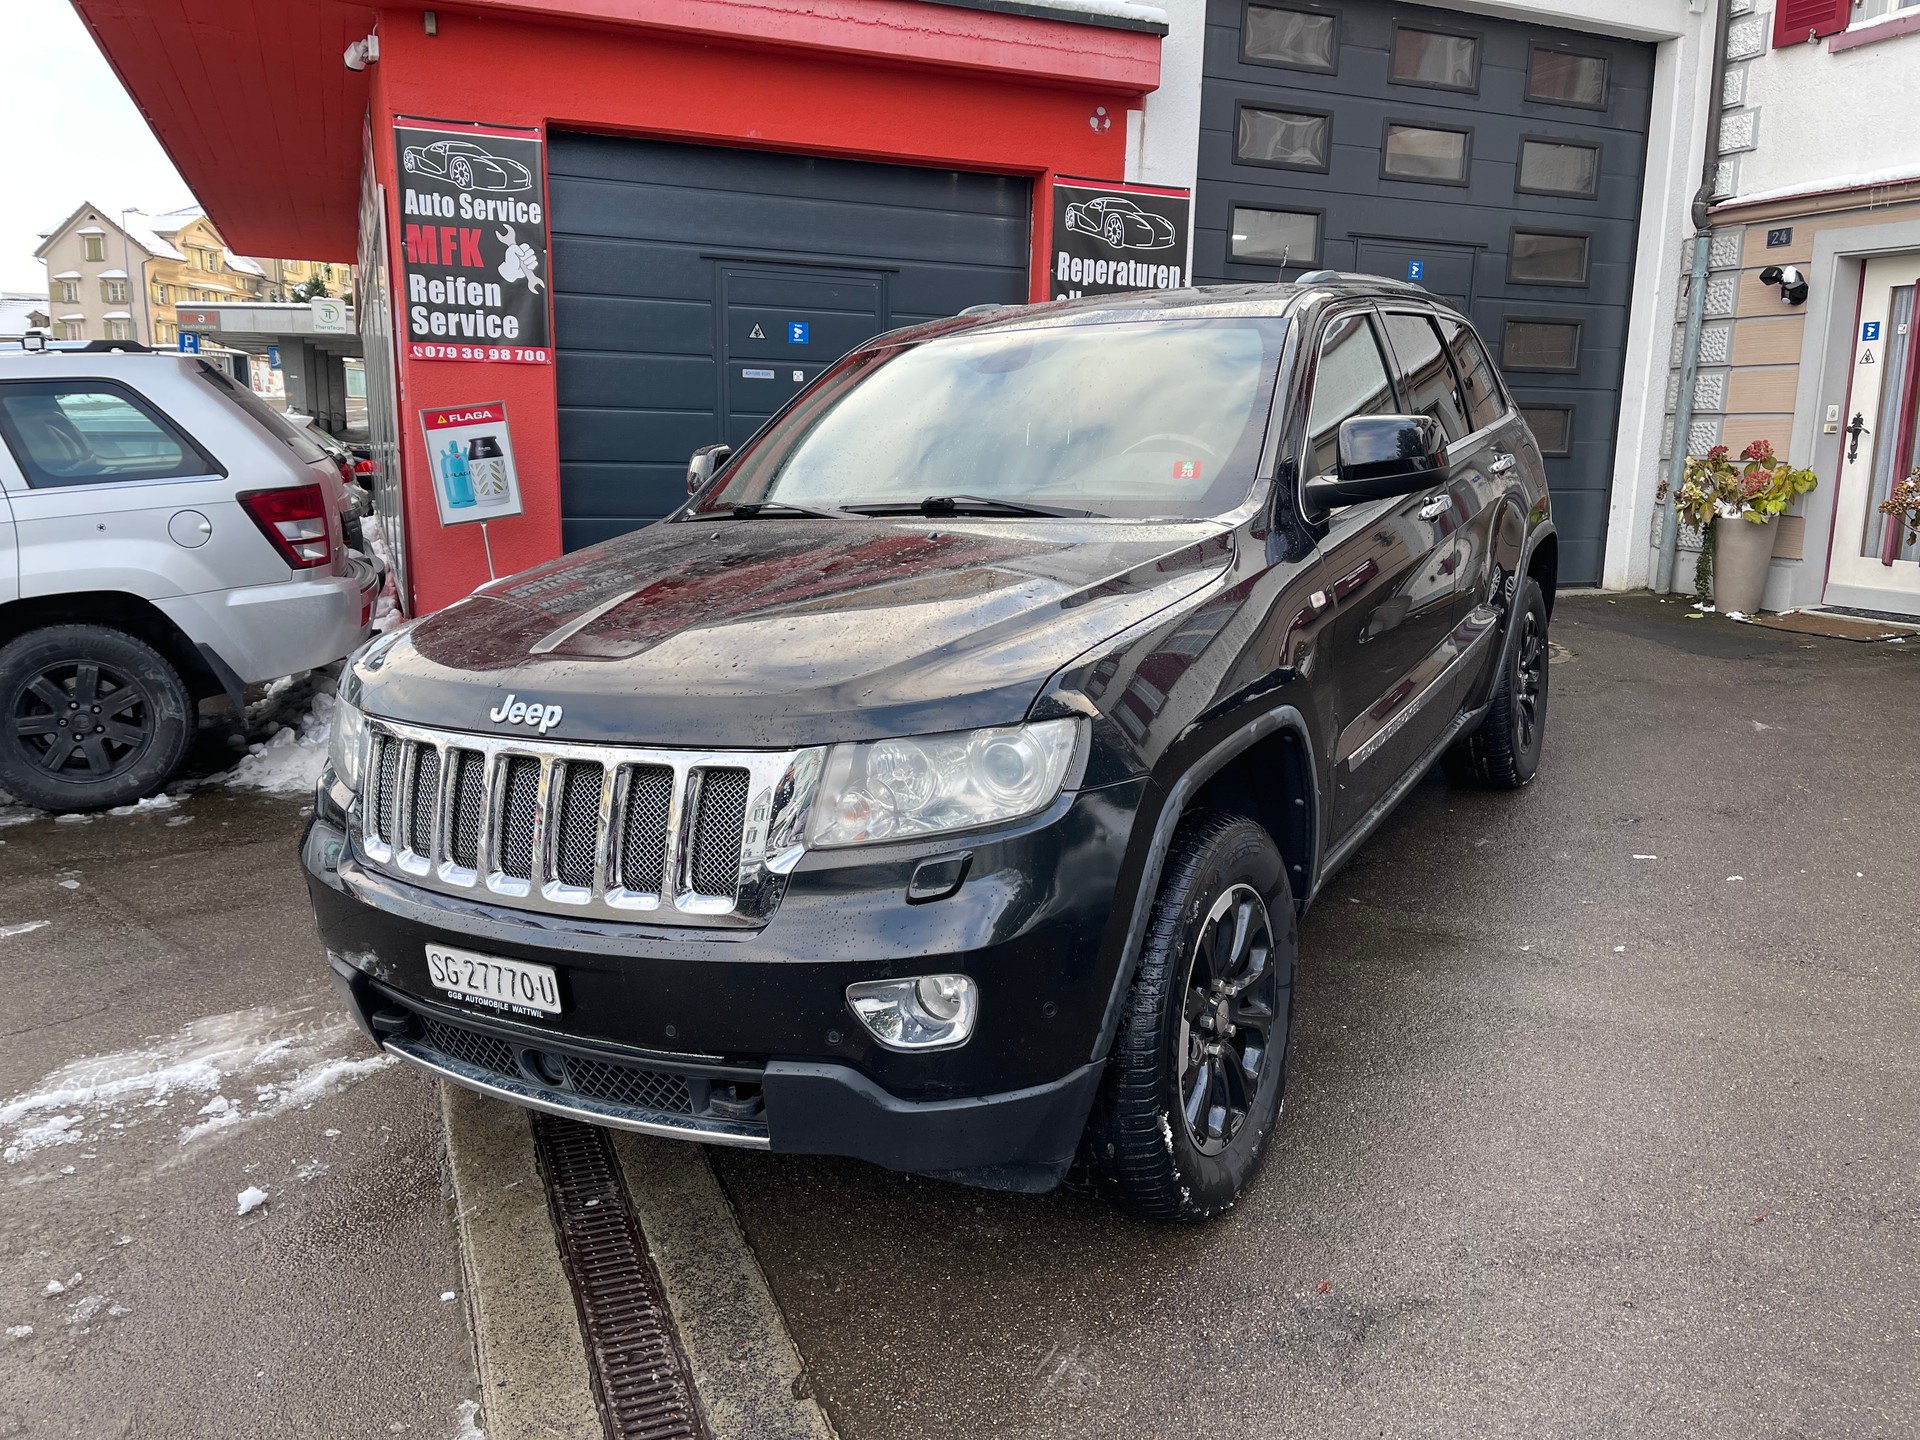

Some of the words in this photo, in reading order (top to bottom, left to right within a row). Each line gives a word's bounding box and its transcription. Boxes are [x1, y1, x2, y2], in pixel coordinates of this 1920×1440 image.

[404, 188, 455, 218] Auto
[459, 193, 542, 224] Service
[405, 223, 484, 268] MFK
[1771, 231, 1788, 245] 24
[1057, 251, 1181, 289] Reperaturen
[408, 273, 501, 307] Reifen
[411, 306, 519, 339] Service
[184, 334, 194, 347] P
[425, 345, 457, 359] 079
[461, 347, 484, 360] 36
[488, 349, 510, 361] 98
[515, 350, 546, 362] 700
[448, 410, 492, 423] FLAGA
[1180, 469, 1194, 477] 20
[489, 694, 564, 735] Jeep
[447, 990, 463, 1001] GGB
[464, 993, 509, 1012] AUTOMOBILE
[512, 1005, 544, 1019] WATTWIL
